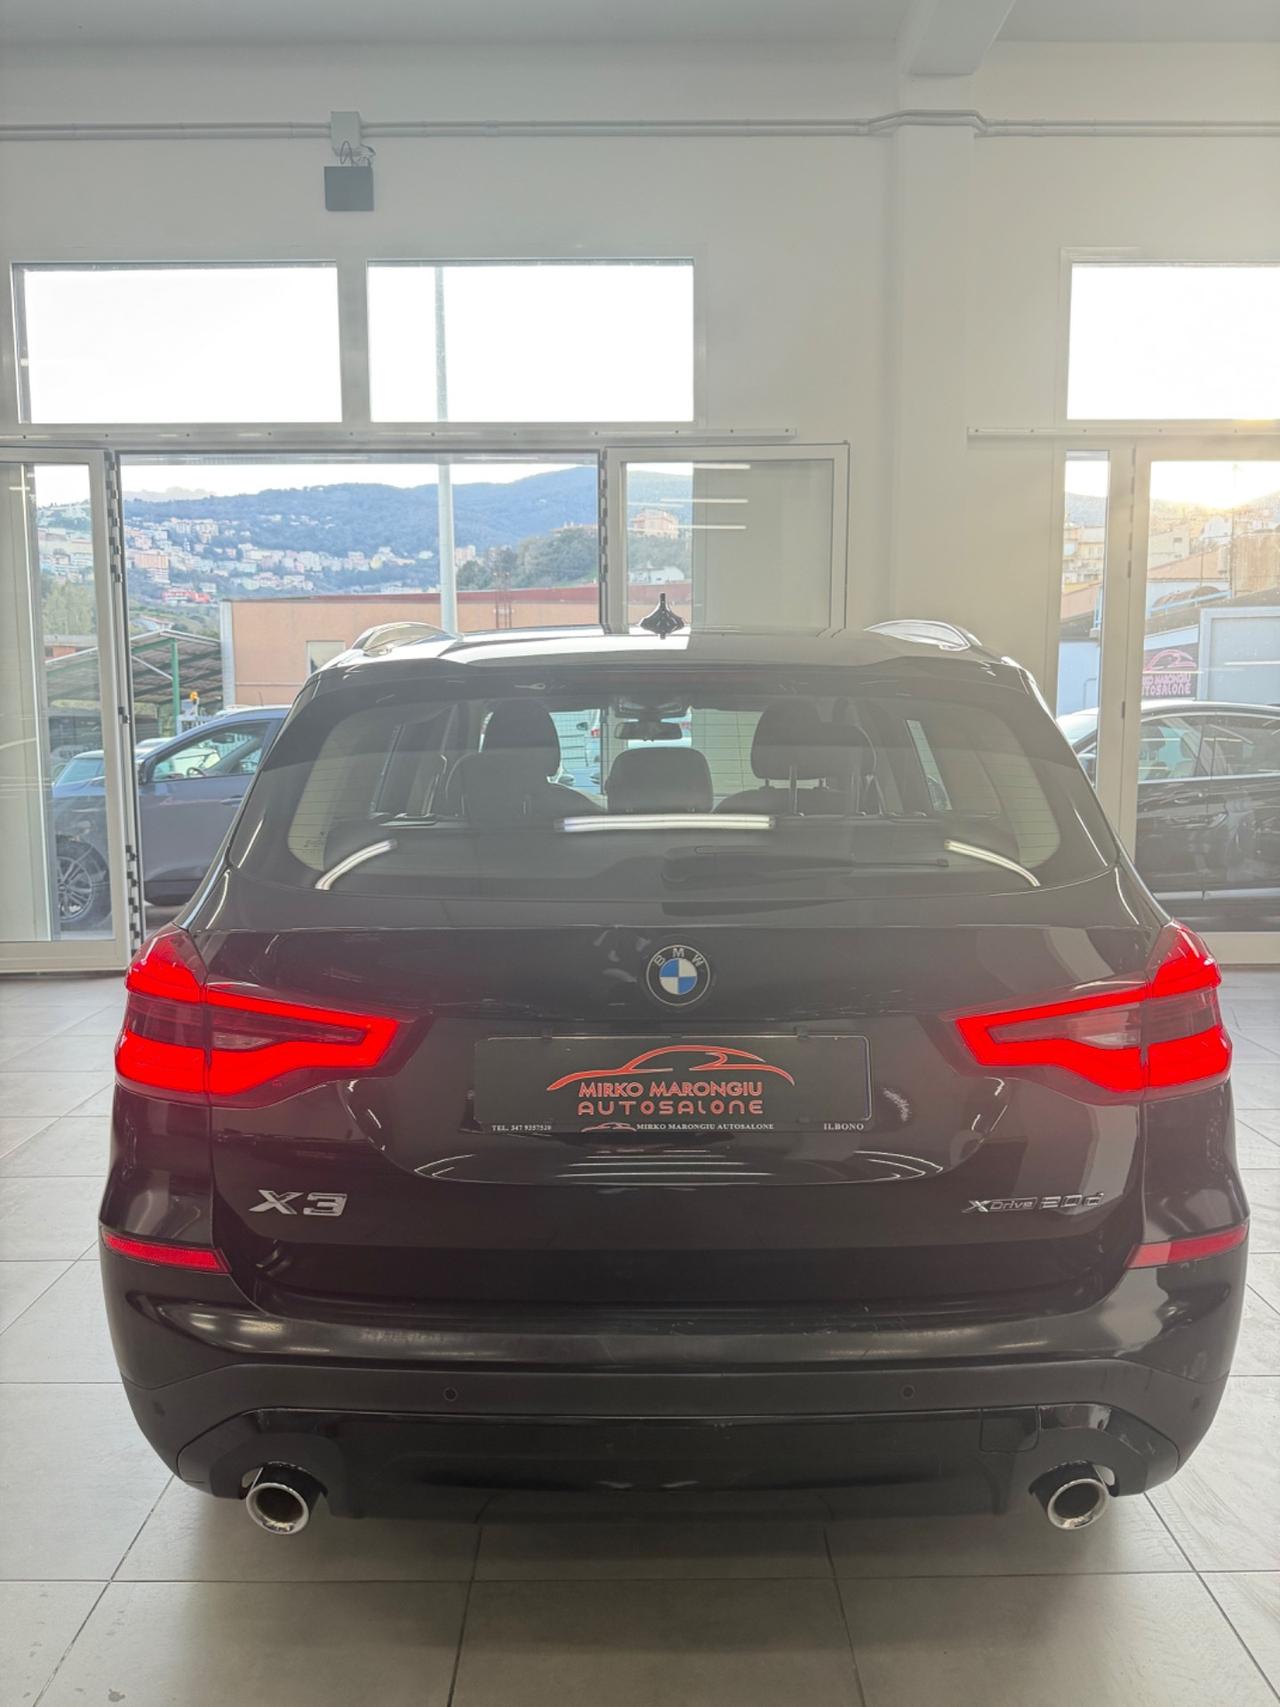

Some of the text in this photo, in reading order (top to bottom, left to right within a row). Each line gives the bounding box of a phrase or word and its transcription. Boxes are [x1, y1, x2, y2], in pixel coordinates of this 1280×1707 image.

[1142, 683, 1191, 696] TOSALONE
[654, 947, 704, 967] BMW
[578, 1081, 763, 1098] MIRKO MARONGIU
[578, 1101, 763, 1115] AUTOSALONE
[823, 1122, 865, 1131] ILBONO
[248, 1189, 348, 1217] X3
